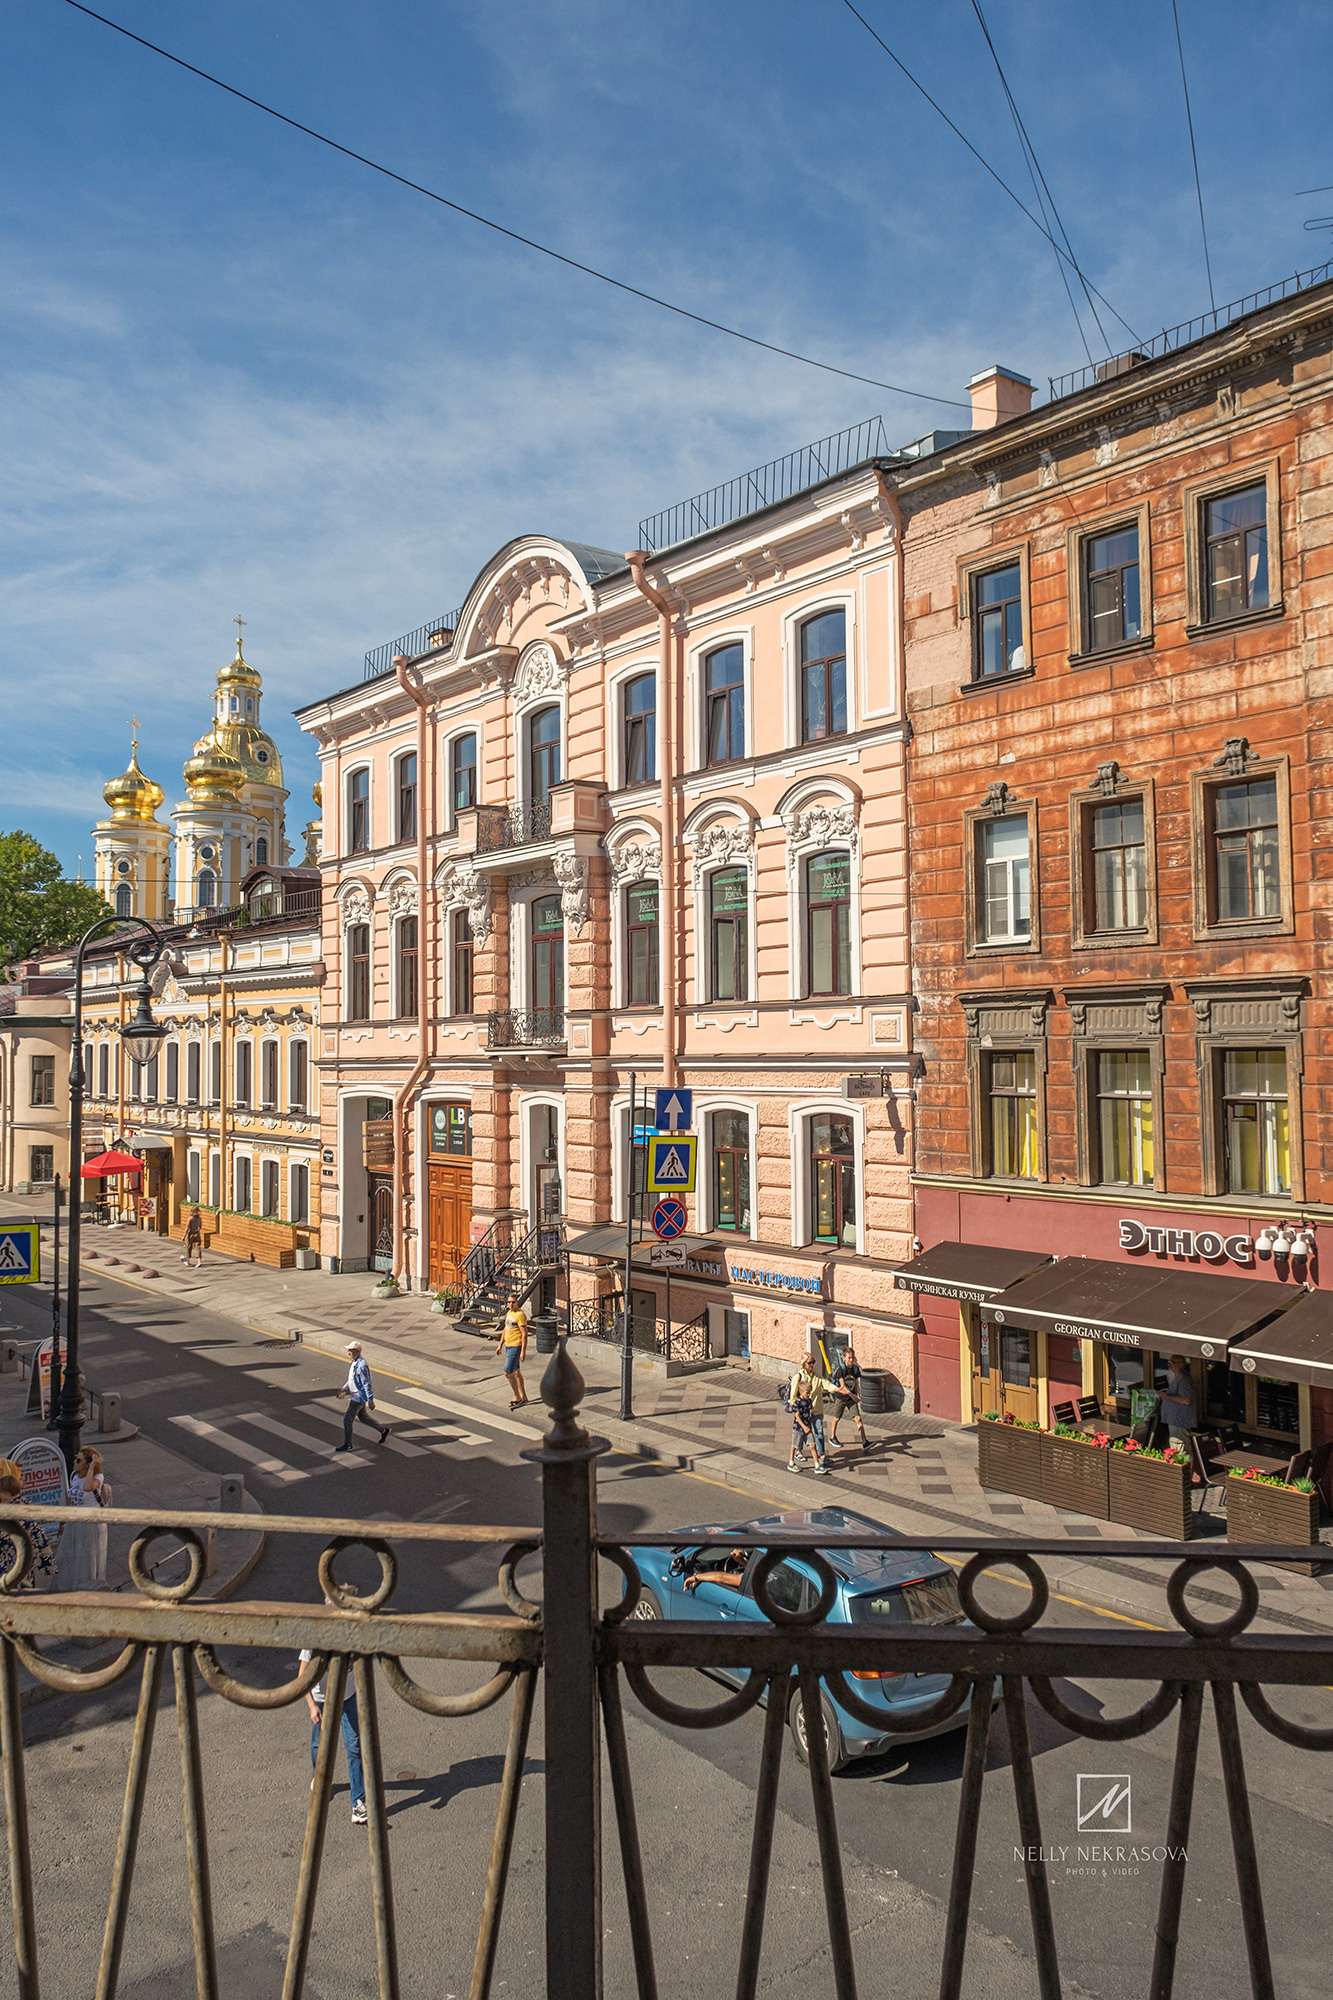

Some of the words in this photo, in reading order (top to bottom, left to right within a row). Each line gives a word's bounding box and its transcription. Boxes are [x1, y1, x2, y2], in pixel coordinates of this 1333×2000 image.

[450, 1108, 465, 1125] LB
[673, 1259, 722, 1276] ОВАРЫ
[730, 1266, 820, 1293] МАСТЕРОВОЙ
[910, 1281, 958, 1298] ГРУЗИНСКАЯ
[959, 1290, 985, 1302] КУХНЯ
[1054, 1322, 1101, 1339] GEORGIAN
[1102, 1330, 1140, 1346] CUISINE
[21, 1467, 60, 1482] ЛЮЧИ
[21, 1488, 38, 1496] АМЕНА
